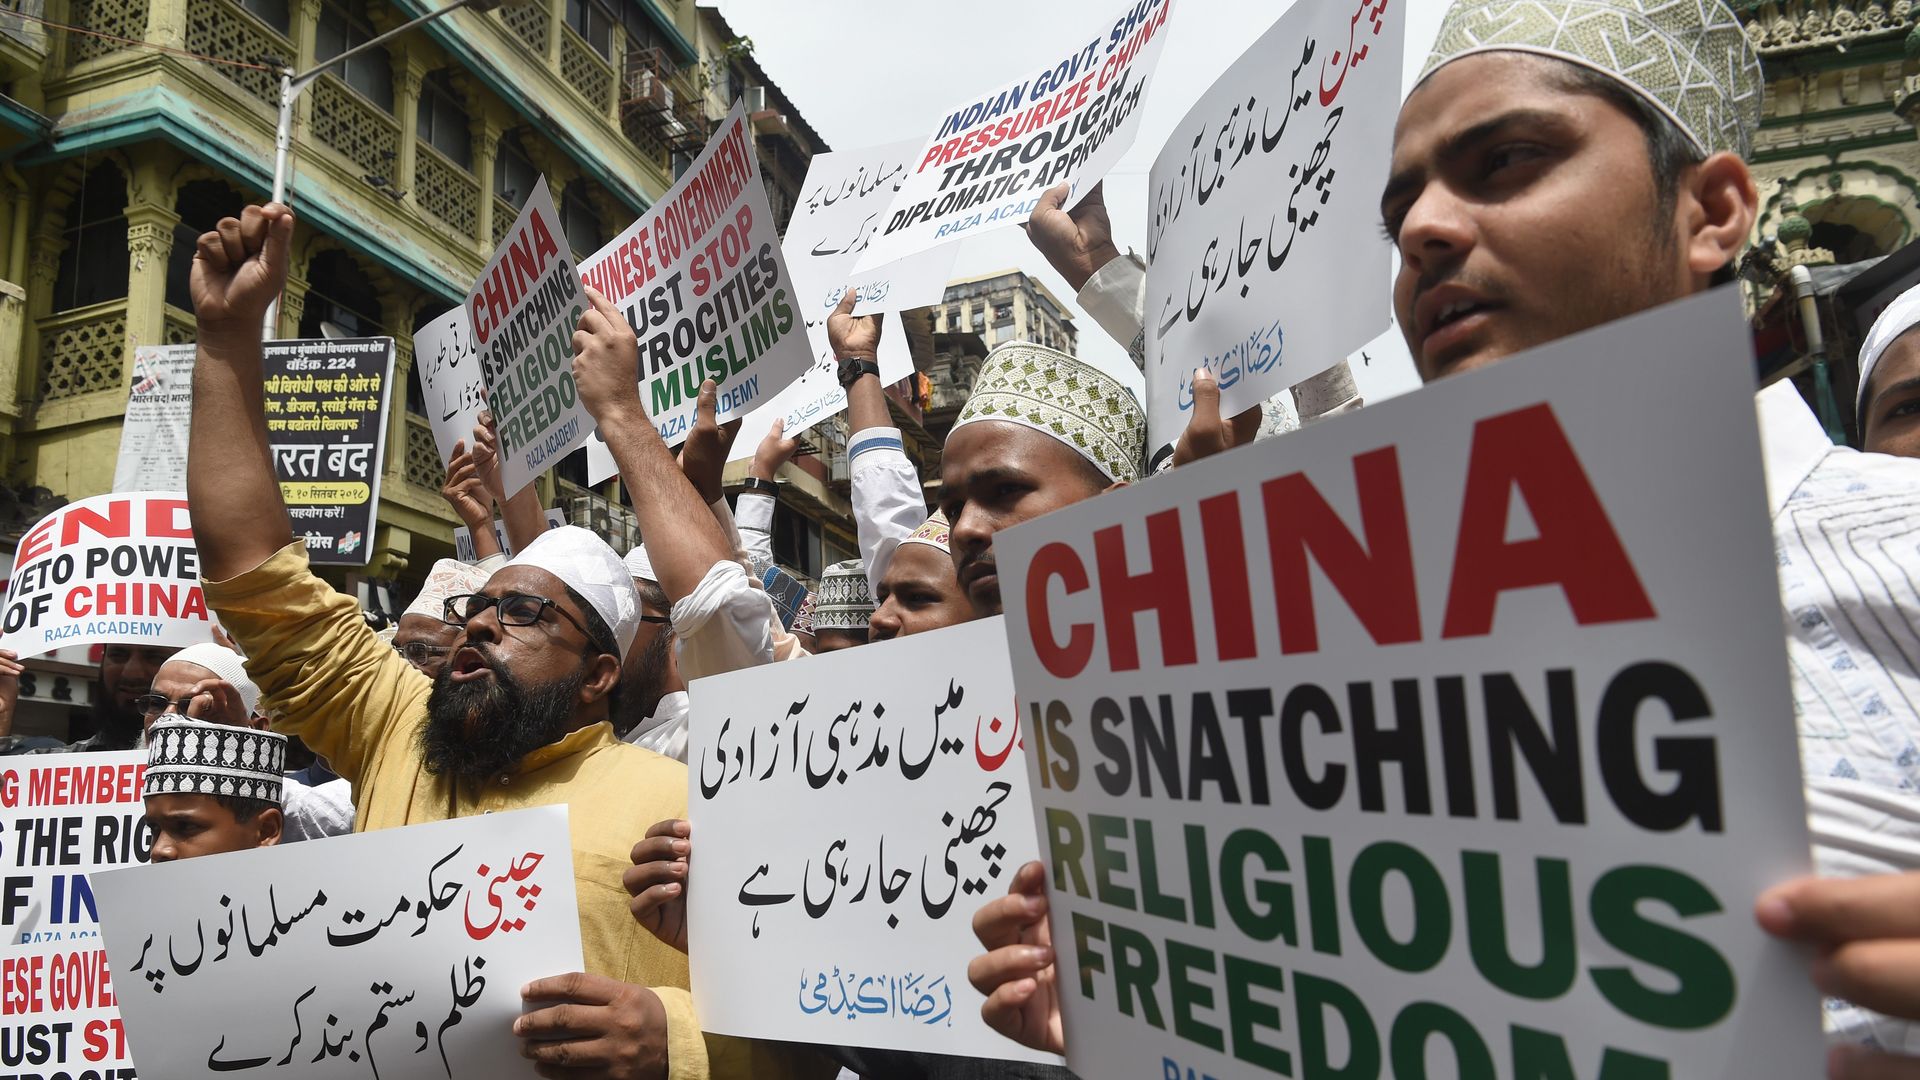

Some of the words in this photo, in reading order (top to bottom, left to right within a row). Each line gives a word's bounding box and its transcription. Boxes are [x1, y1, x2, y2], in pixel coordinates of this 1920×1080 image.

[917, 70, 1096, 174] PRESSURIZE
[1097, 0, 1170, 92] CHINA
[935, 80, 1030, 142] INDIAN
[1030, 36, 1101, 102] GOVT.
[1106, 0, 1160, 54] SHO
[1262, 35, 1316, 153] میں
[1319, 0, 1387, 107] ین
[883, 168, 1031, 237] DIPLOMATIC
[1030, 74, 1147, 192] APPROACH
[937, 65, 1132, 192] THROUGH
[653, 117, 753, 268] GOVERNMENT
[934, 214, 982, 240] RAZA
[984, 178, 1080, 224] ACADY
[472, 207, 558, 345] CHINA
[621, 270, 683, 339] UST
[689, 203, 753, 298] STOP
[637, 242, 779, 383] TROCITIES
[481, 350, 494, 391] IS
[491, 258, 578, 376] SNATCHING
[652, 287, 794, 417] MUSLIMS
[333, 373, 348, 392] की
[370, 373, 381, 391] से
[499, 370, 576, 462] FREEDO
[656, 413, 686, 441] AZA
[269, 443, 324, 478] ारत
[327, 434, 374, 478] बंद
[526, 437, 548, 471] RAZA
[547, 414, 580, 457] ACADEMY
[15, 499, 194, 571] END
[290, 506, 323, 519] सहयोग
[1025, 400, 1659, 679] CHINA
[4, 593, 52, 634] OF
[64, 582, 209, 621] CHINA
[8, 553, 74, 603] VETO
[86, 545, 198, 581] POWE
[44, 624, 81, 643] RAZA
[86, 621, 163, 637] ACADEMY
[701, 694, 810, 800] آزادی
[805, 699, 890, 790] مذہبی
[900, 677, 964, 780] میں
[1030, 699, 1080, 792] IS
[1090, 660, 1726, 835] SNATCHING
[15, 816, 83, 867] THE
[169, 884, 328, 976] مسلمانوں
[326, 843, 464, 948] حکومت
[464, 851, 545, 941] چینی
[737, 860, 796, 939] ہے
[1044, 808, 1738, 1032] RELIGIOUS
[2, 956, 43, 1015] ESE
[50, 949, 118, 1012] GOVE
[130, 933, 165, 994] پر
[1, 1022, 73, 1067] UST
[311, 1014, 360, 1064] بند
[366, 981, 415, 1080] ستم
[414, 1020, 429, 1054] و
[438, 956, 487, 1079] ظلم
